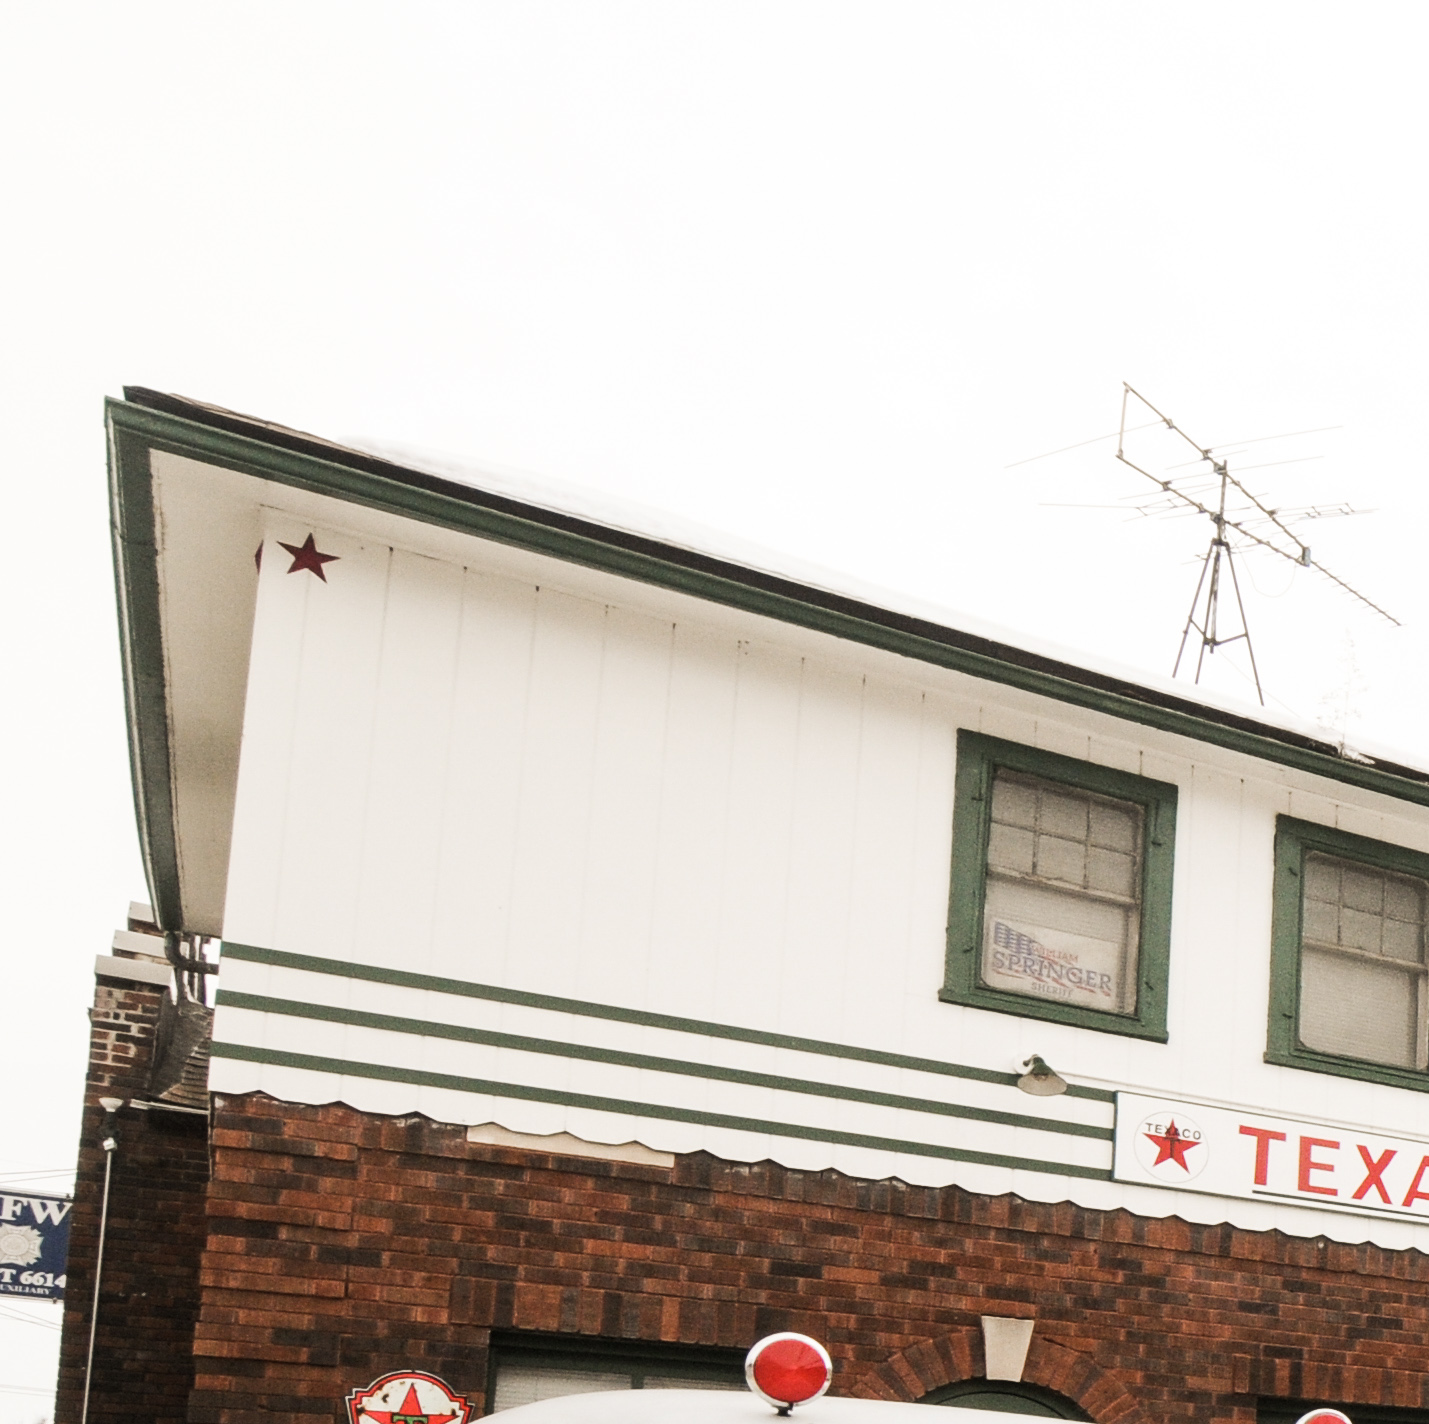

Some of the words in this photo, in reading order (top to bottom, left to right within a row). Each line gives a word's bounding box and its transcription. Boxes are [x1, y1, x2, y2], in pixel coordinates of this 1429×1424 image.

[992, 951, 1112, 992] SPRINGER
[1145, 1122, 1202, 1140] TEXACO
[20, 1270, 67, 1289] 6614
